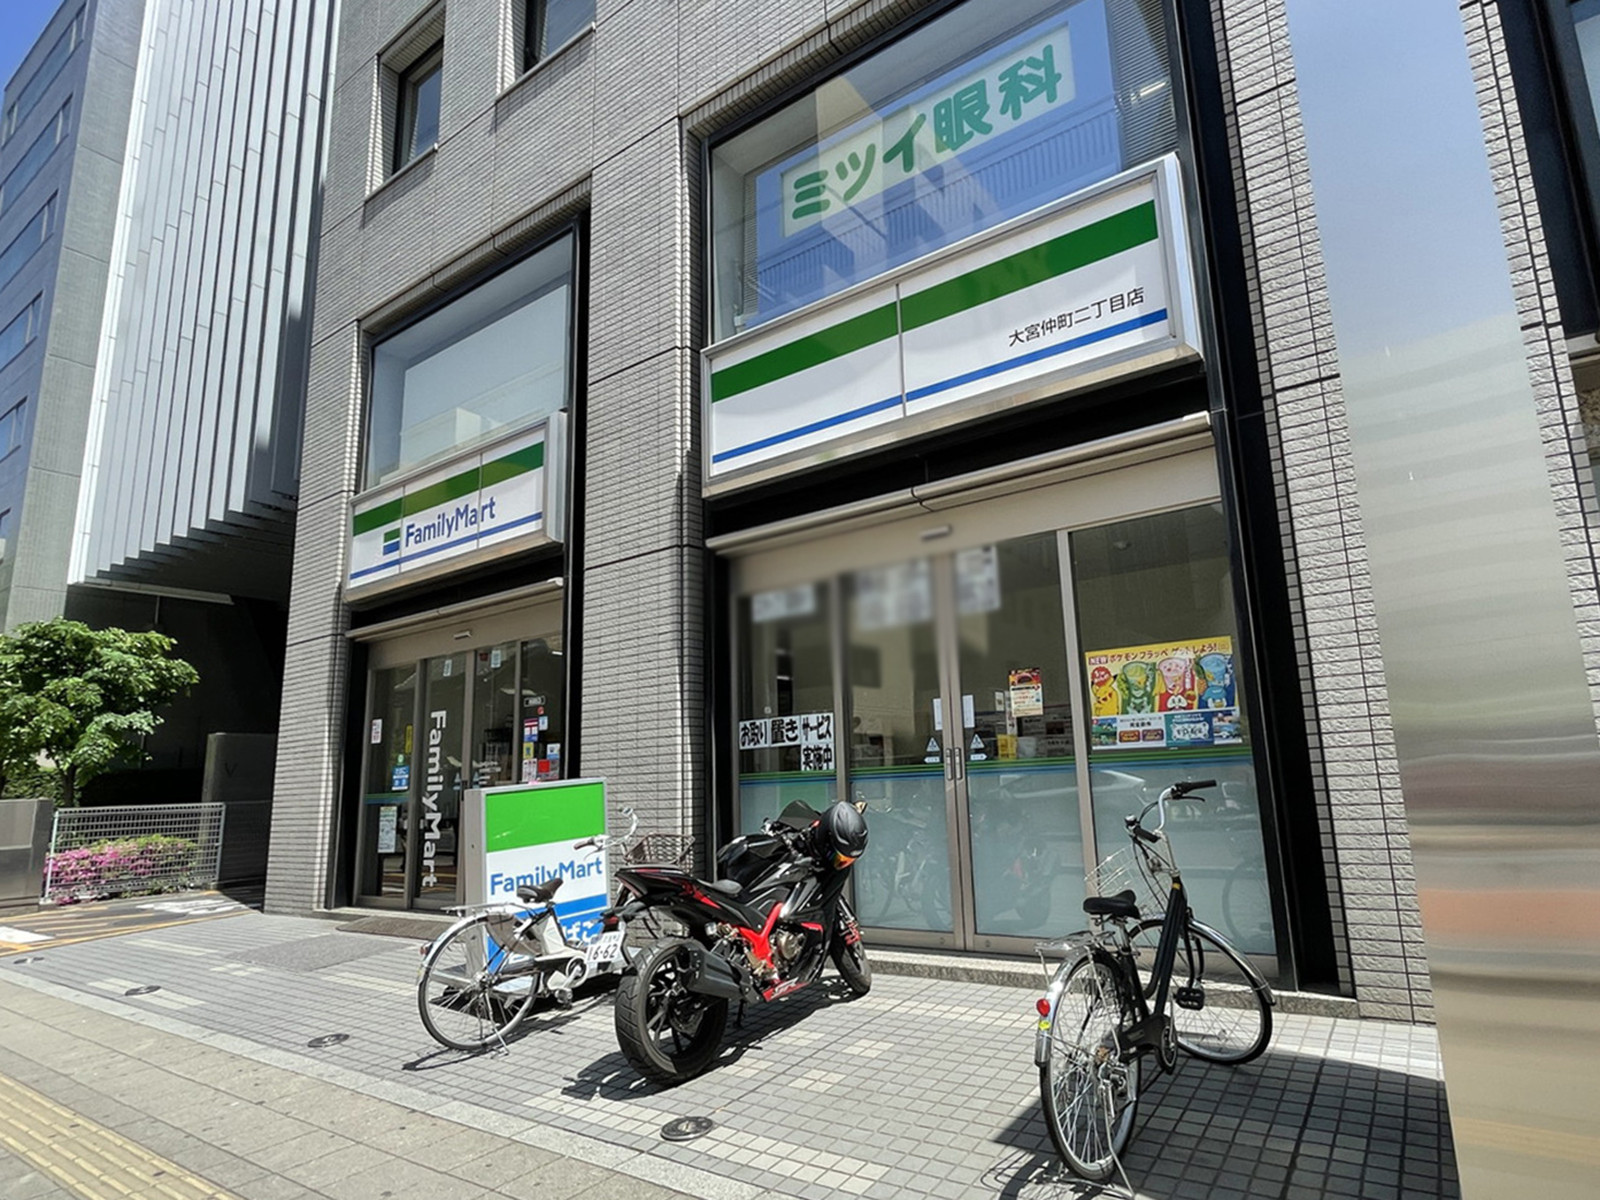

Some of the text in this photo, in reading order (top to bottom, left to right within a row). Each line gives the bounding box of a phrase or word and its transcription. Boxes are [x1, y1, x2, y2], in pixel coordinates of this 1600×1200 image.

[792, 43, 1062, 220] ミツイ眼科
[1008, 288, 1144, 347] 大宮仲町二丁目店
[405, 496, 496, 547] FamilyMart
[802, 743, 833, 771] 実施中
[422, 710, 447, 888] FamilyMart
[490, 857, 603, 895] FamilyMart
